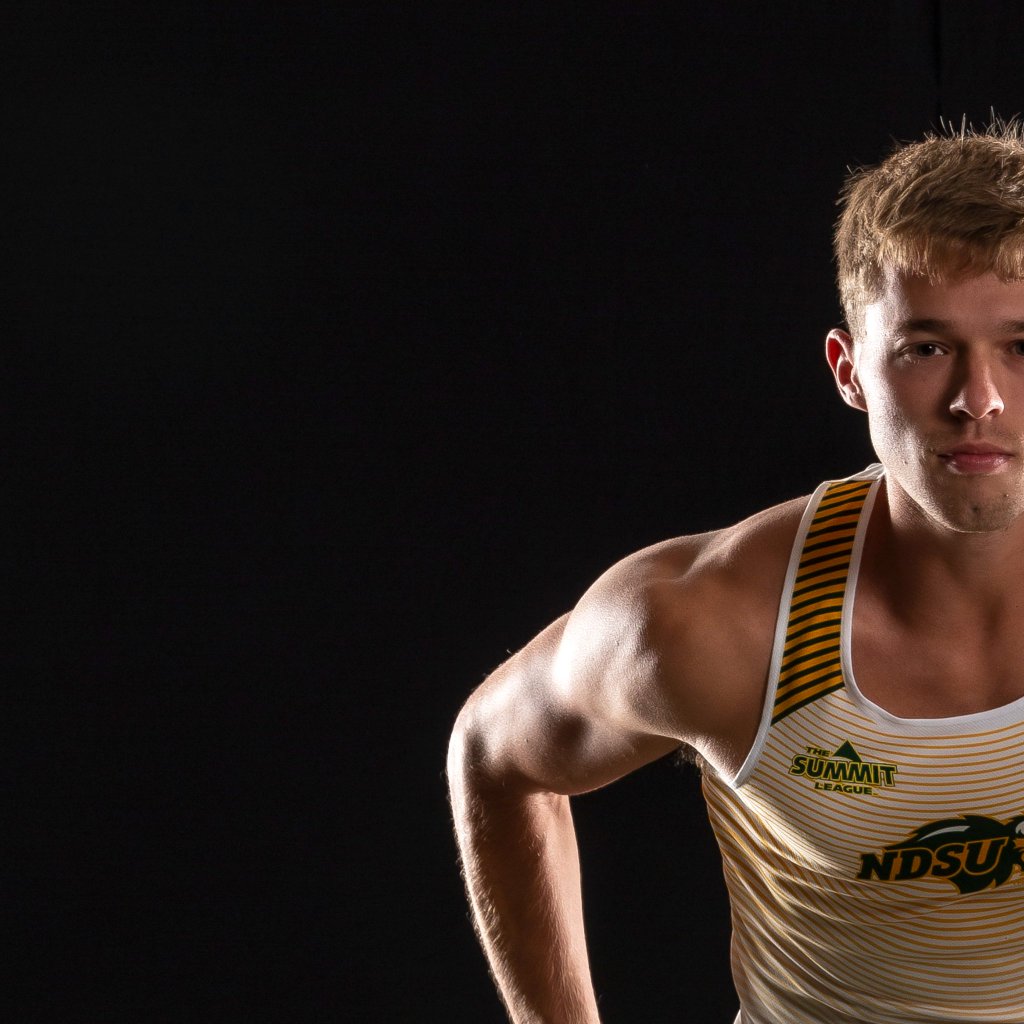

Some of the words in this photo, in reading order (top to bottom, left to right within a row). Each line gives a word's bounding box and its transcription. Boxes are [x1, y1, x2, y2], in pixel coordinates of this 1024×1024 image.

[805, 746, 831, 757] THE
[788, 753, 898, 787] SUMMIT
[814, 782, 873, 795] LEAGUE
[856, 836, 1009, 882] NDSU
